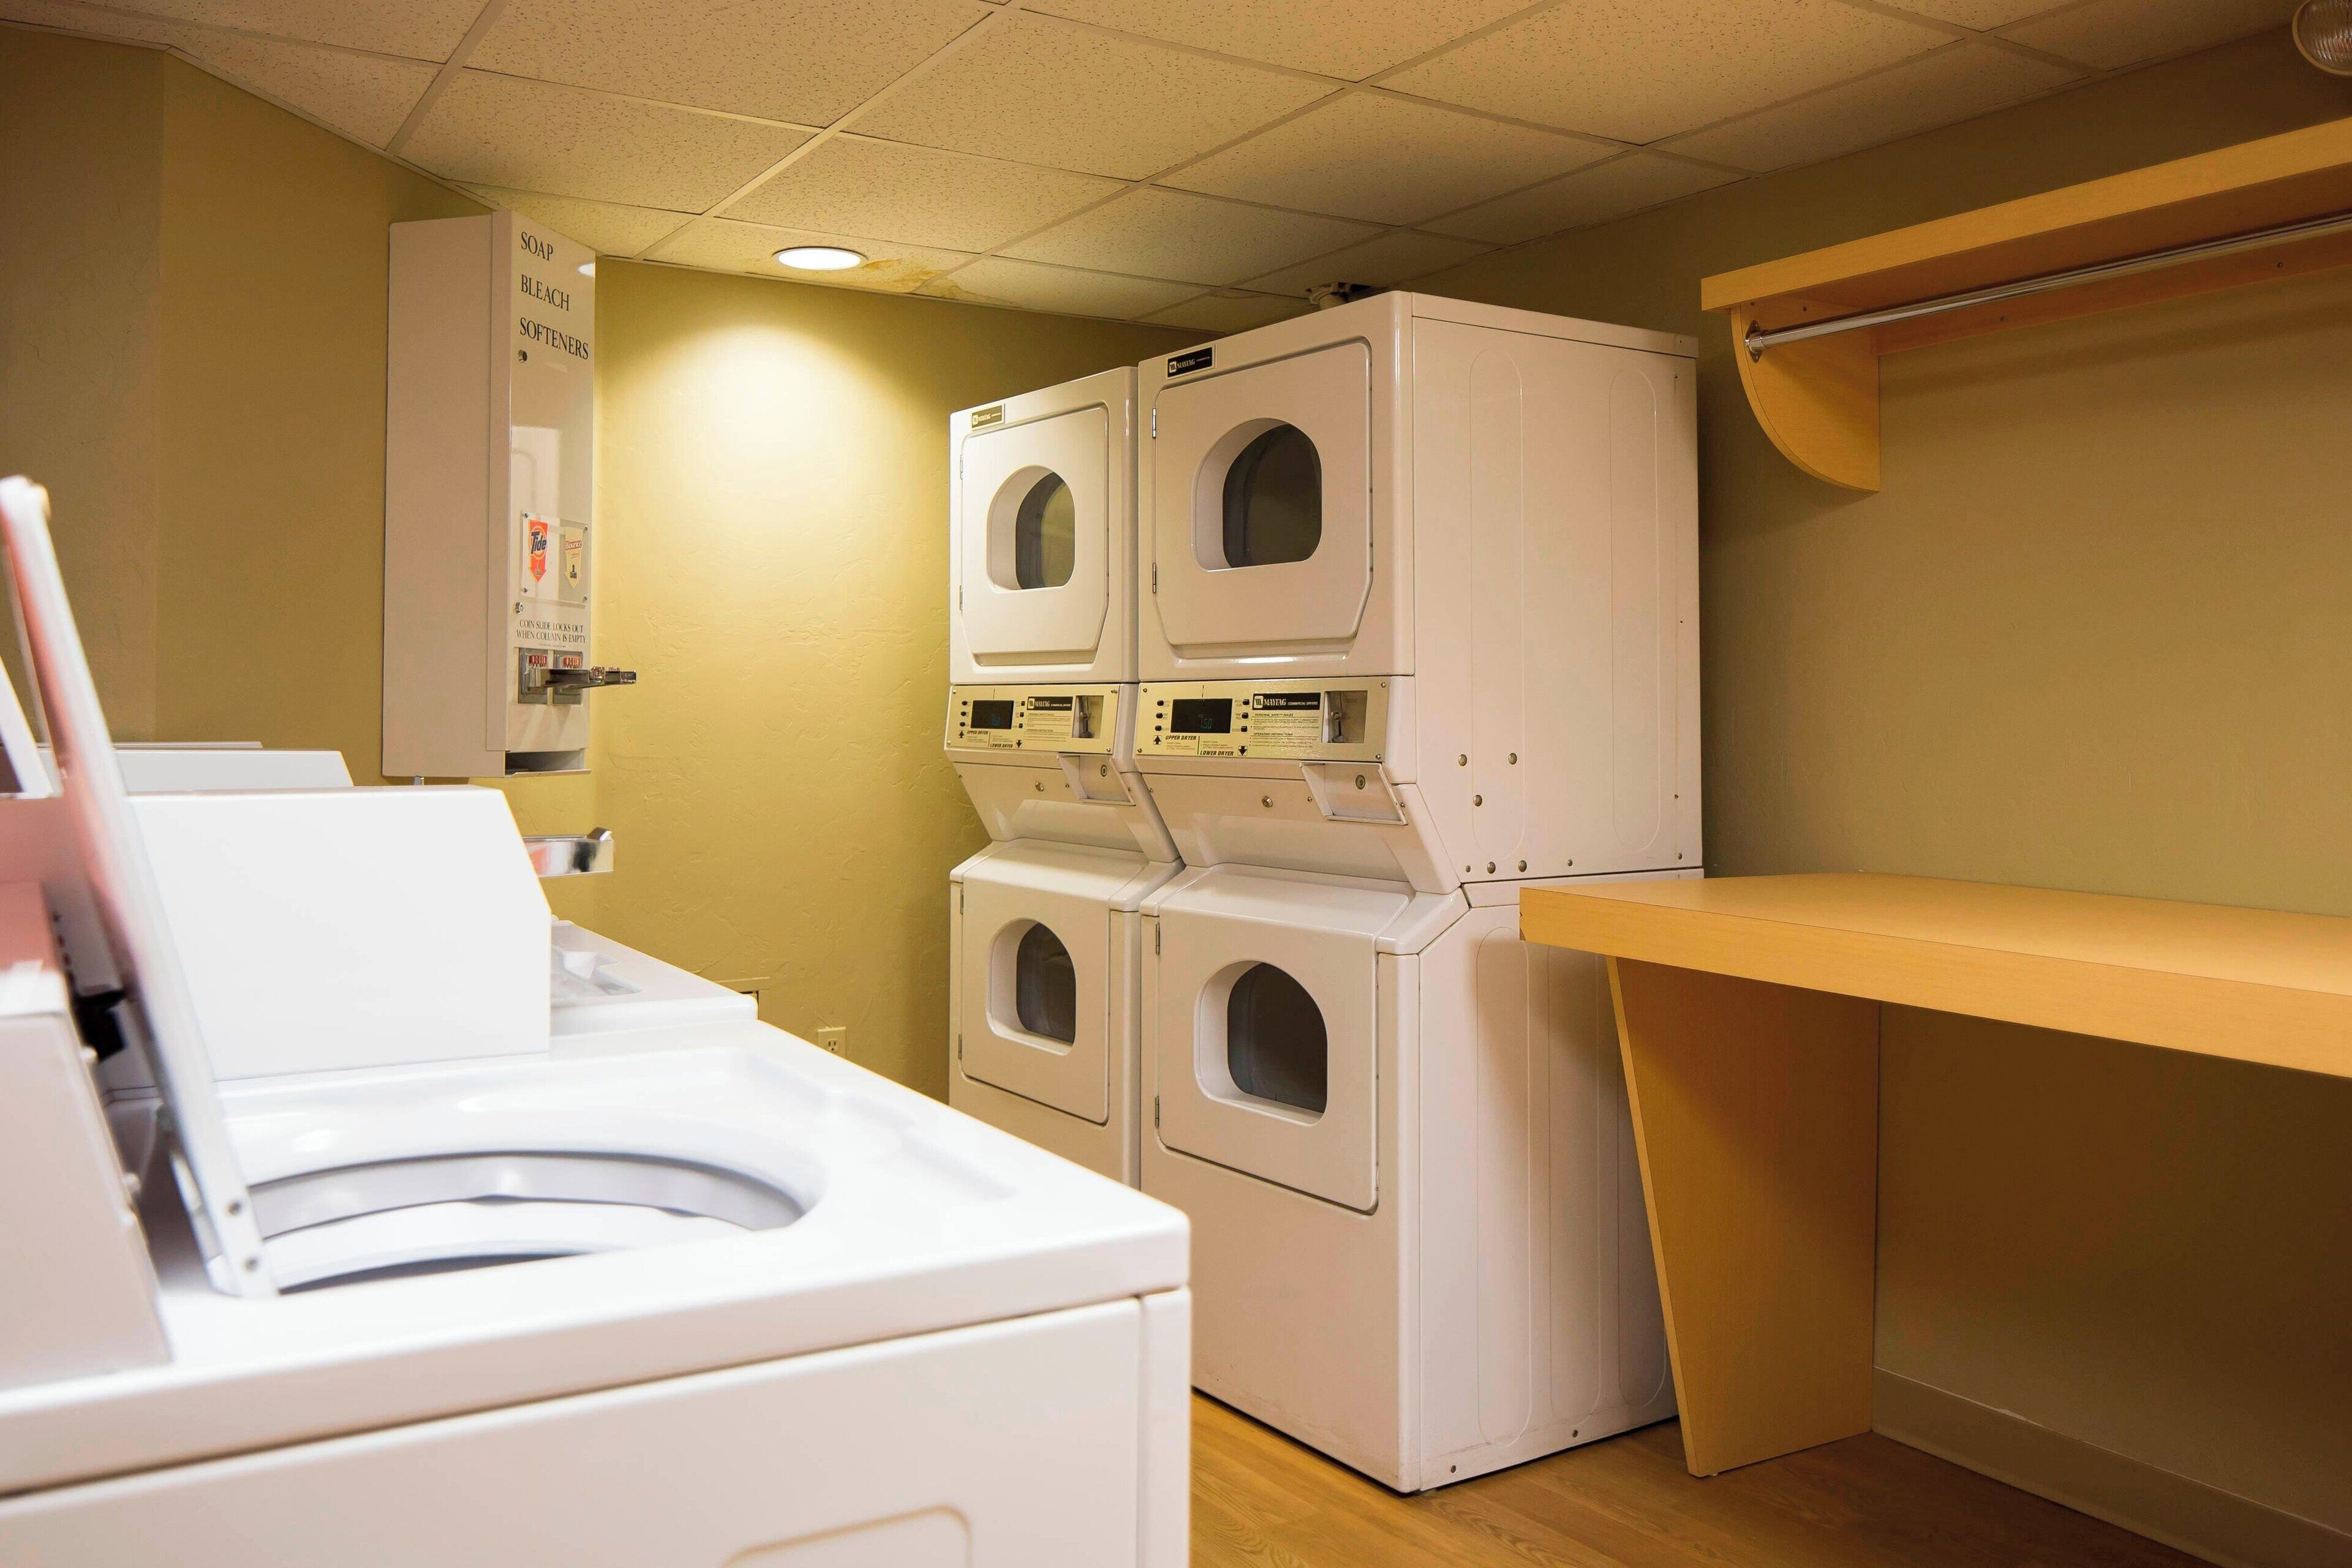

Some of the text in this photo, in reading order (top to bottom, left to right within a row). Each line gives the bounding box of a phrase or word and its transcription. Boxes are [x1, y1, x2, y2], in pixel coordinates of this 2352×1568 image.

[521, 231, 554, 262] SOAP
[521, 274, 570, 311] BLEACH
[520, 317, 589, 360] SOFTENERS
[531, 531, 546, 554] Tide
[516, 629, 534, 639] WHEN
[536, 631, 560, 641] COLUMN
[568, 634, 586, 643] EMPTY
[519, 619, 583, 633] COIN SLIDE LOCKS OUT
